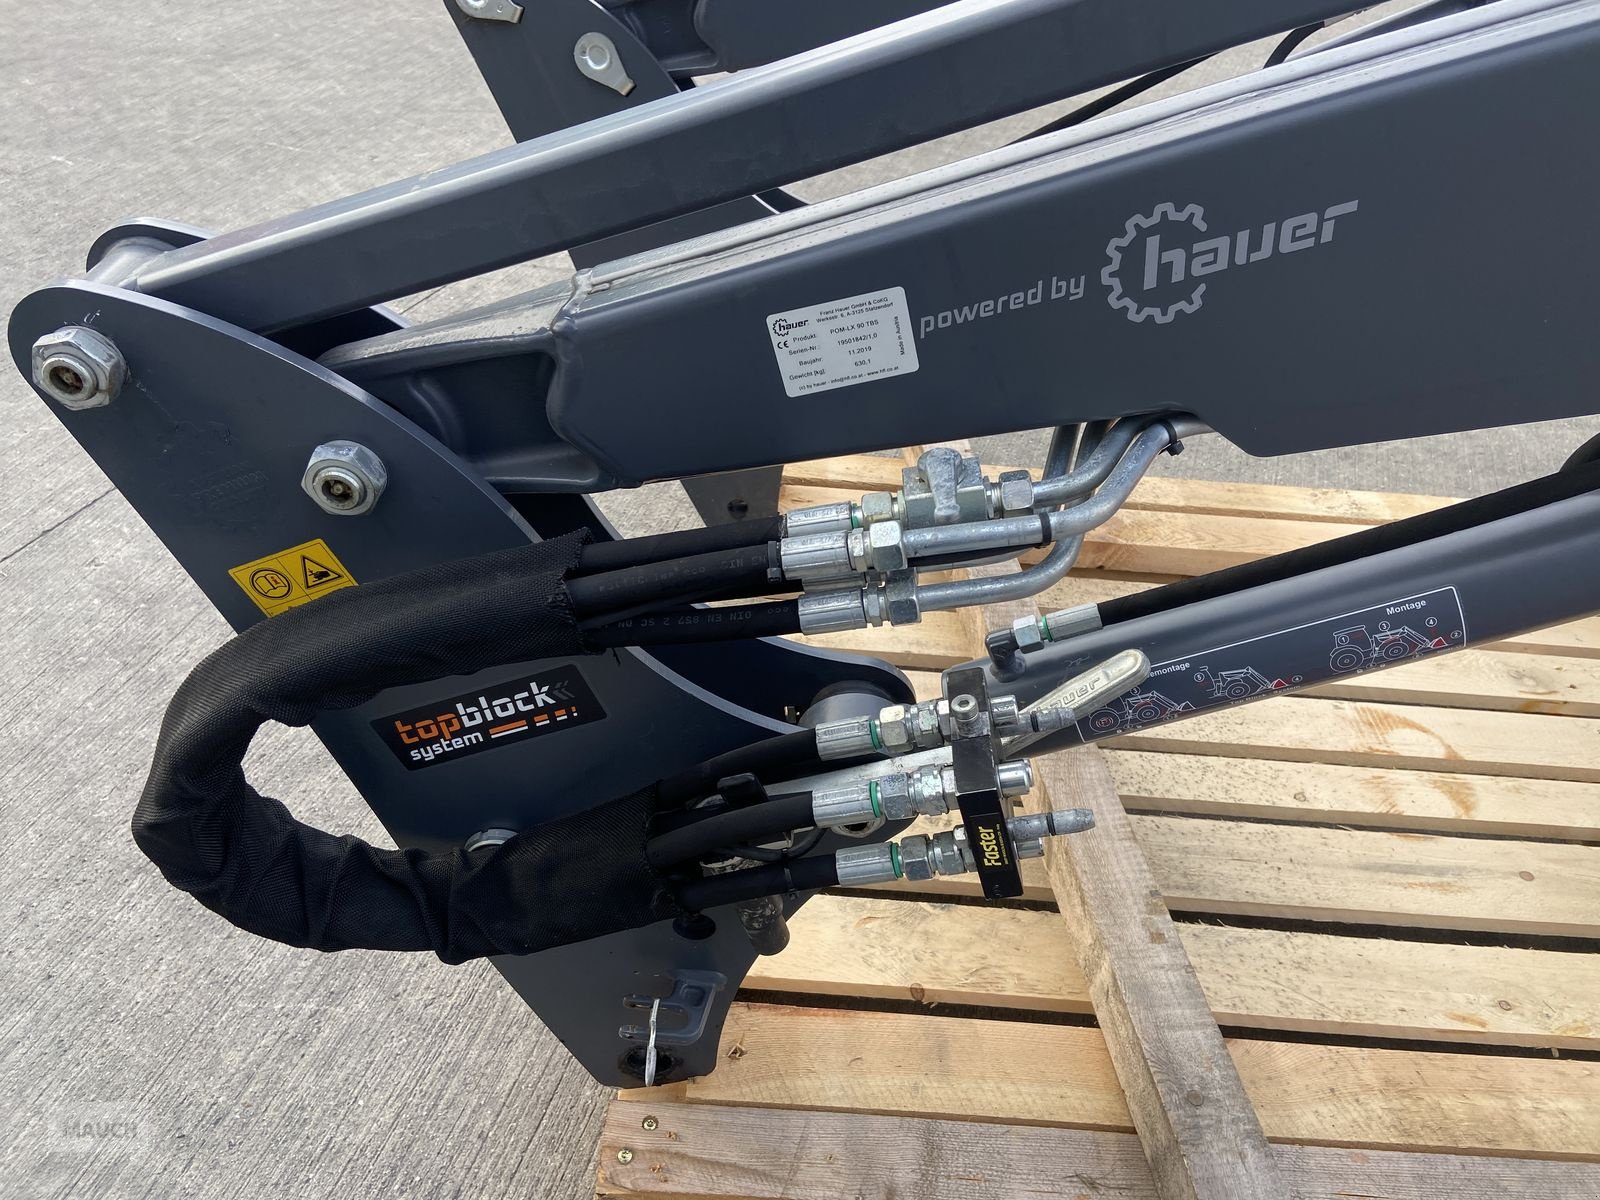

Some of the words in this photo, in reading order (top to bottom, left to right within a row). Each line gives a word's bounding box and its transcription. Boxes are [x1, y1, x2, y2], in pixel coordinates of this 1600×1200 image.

[1142, 200, 1359, 291] hauer
[845, 308, 864, 316] A-3125
[919, 281, 1043, 338] powered
[1050, 275, 1086, 300] by
[778, 319, 809, 331] hauer
[829, 324, 855, 334] POM-LX
[788, 371, 813, 380] Gewicht
[1386, 600, 1427, 616] Montage
[1150, 661, 1191, 678] emontage
[410, 731, 484, 761] system
[978, 826, 1002, 866] Faster
